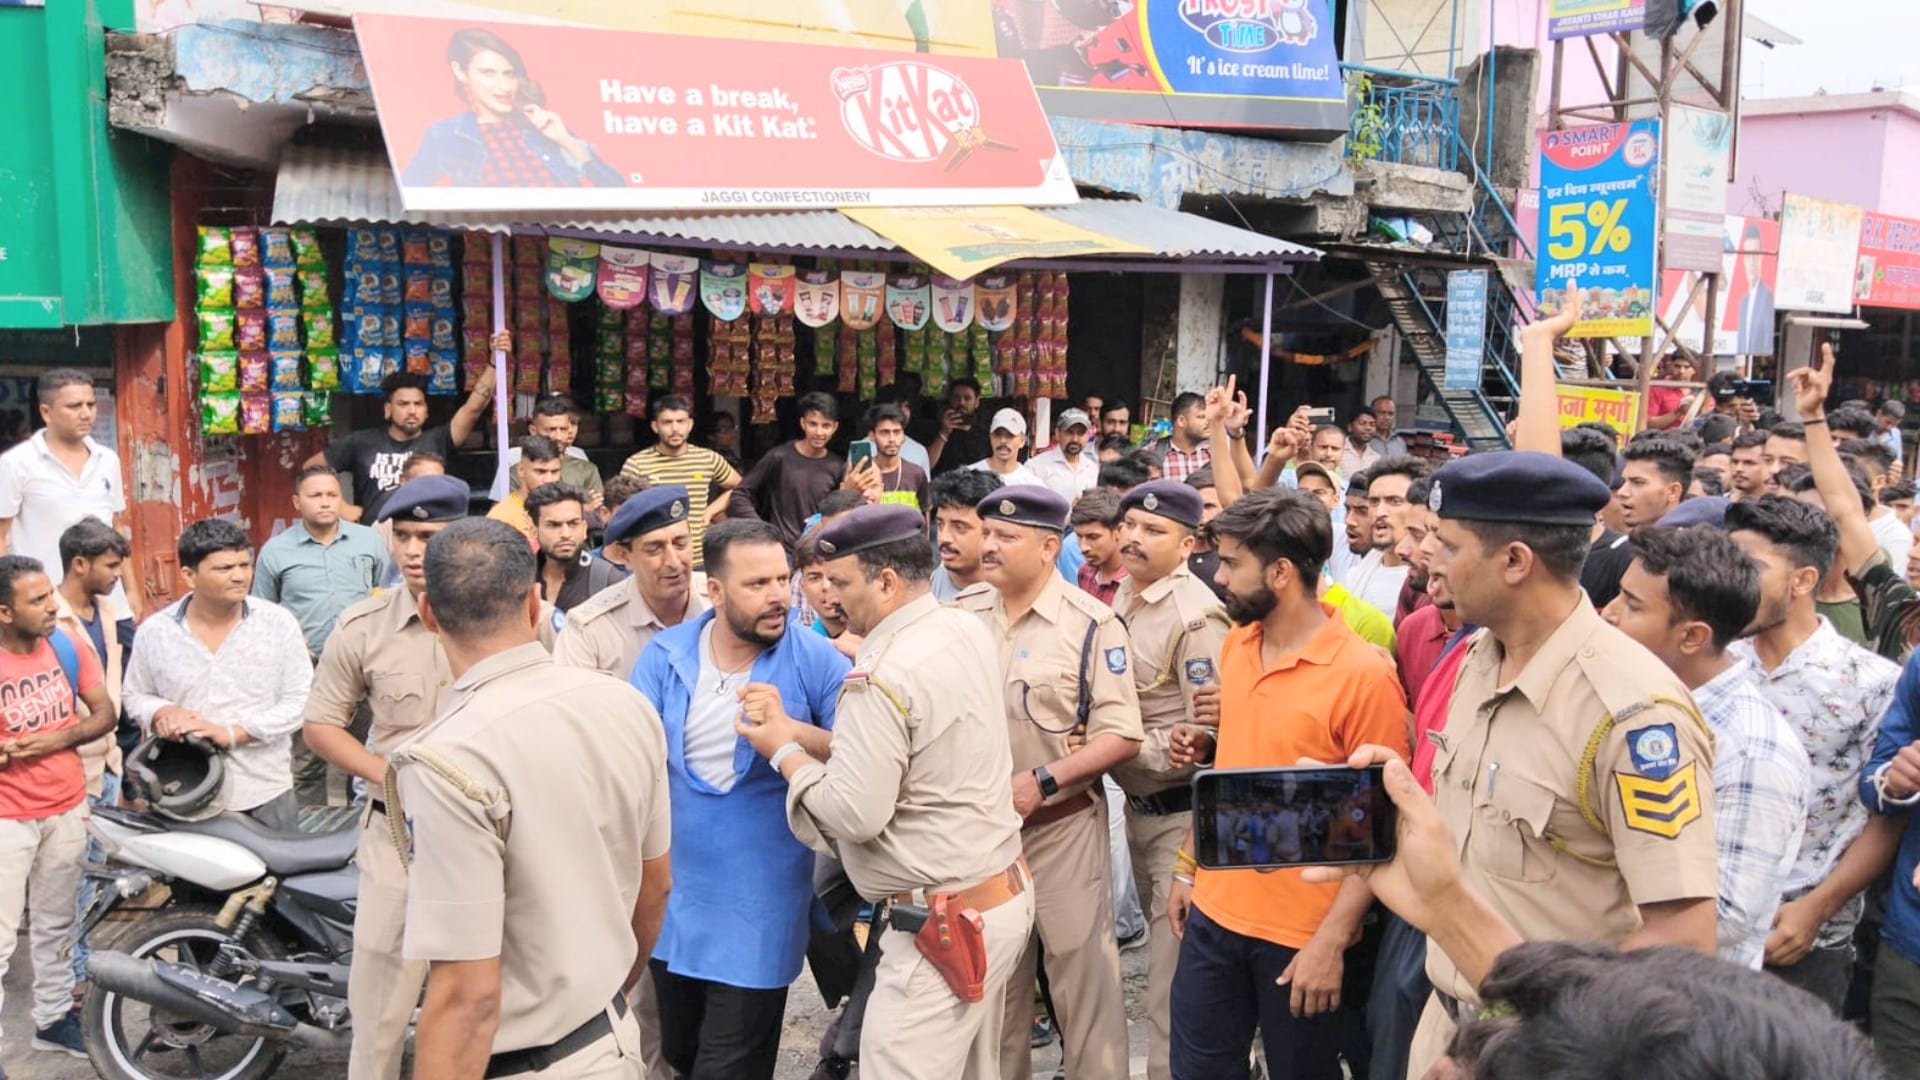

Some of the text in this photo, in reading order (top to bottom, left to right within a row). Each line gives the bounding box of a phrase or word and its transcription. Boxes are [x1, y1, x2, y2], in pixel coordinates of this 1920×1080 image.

[1218, 58, 1239, 76] ice
[1242, 64, 1290, 79] cream
[1292, 62, 1329, 80] time!
[599, 78, 799, 115] Have a break,
[603, 109, 678, 135] have
[687, 118, 706, 136] a
[713, 113, 755, 137] Kit
[856, 64, 972, 158] KitKat
[1563, 124, 1620, 146] SMART
[1571, 143, 1610, 158] POINT
[701, 191, 872, 204] JAGGI CONFECTIONERY
[1548, 199, 1631, 260] 5%
[1550, 263, 1588, 279] MRP
[5, 680, 69, 724] DENIM
